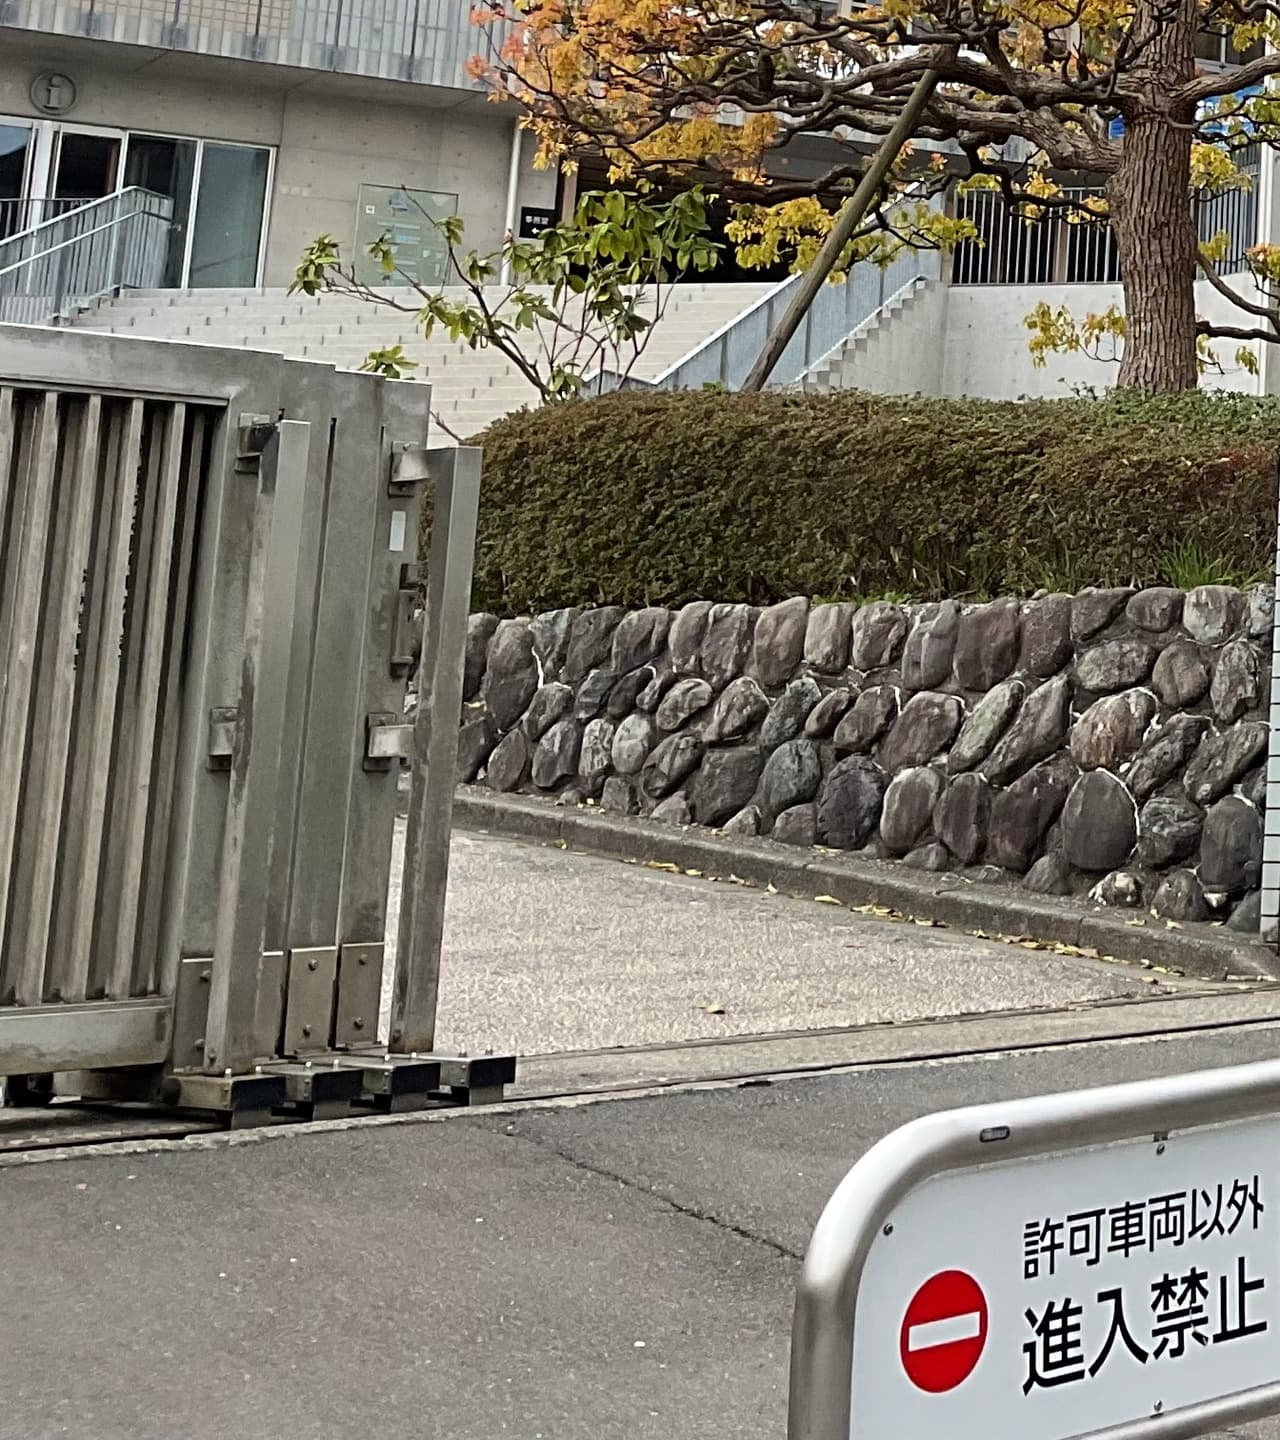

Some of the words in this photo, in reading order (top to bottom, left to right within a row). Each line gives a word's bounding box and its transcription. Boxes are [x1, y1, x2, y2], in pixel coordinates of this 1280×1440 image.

[1022, 1174, 1264, 1280] 許可車両以外
[1021, 1256, 1268, 1396] 進入禁止
